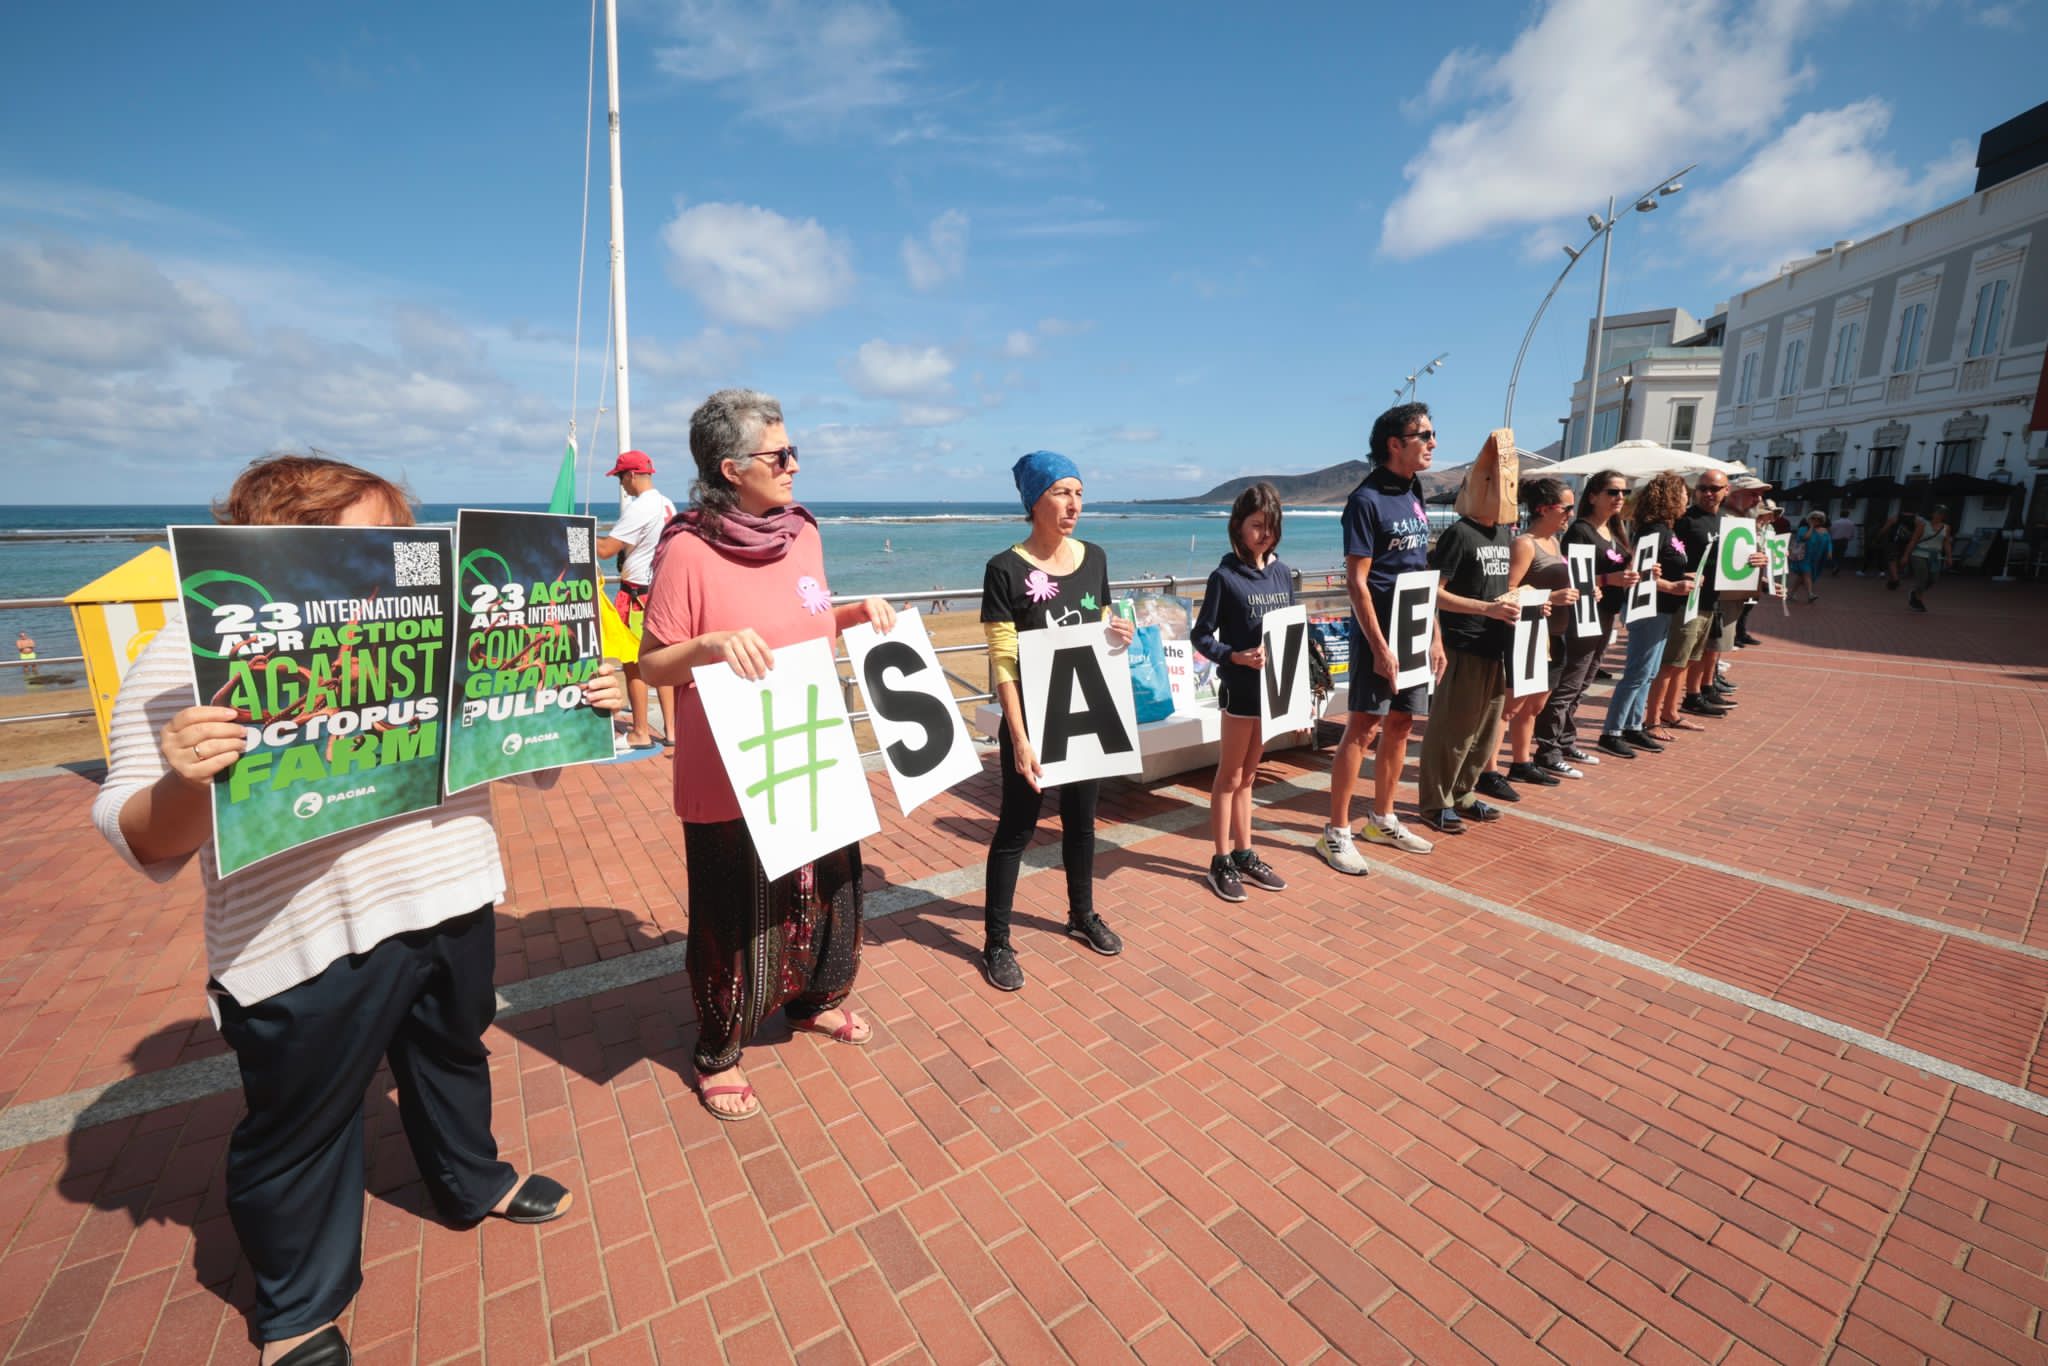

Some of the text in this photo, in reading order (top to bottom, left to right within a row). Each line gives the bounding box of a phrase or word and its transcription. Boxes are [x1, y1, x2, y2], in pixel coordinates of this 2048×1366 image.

[1632, 545, 1656, 609] E
[1721, 527, 1756, 581] C
[305, 595, 443, 626] INTERNATIONAL
[471, 583, 525, 613] 23
[528, 603, 596, 625] INTERNACIONAL
[529, 579, 593, 605] ACTO
[1571, 557, 1597, 624] H
[211, 602, 302, 636] 23
[218, 630, 305, 657] APR
[310, 618, 444, 649] ACTION
[1398, 587, 1431, 673] E
[1520, 603, 1544, 680] T
[466, 621, 599, 673] CONTRA LA
[1263, 622, 1305, 719] V
[229, 641, 443, 721] AGAINST
[464, 659, 599, 699] GRANJA
[465, 684, 591, 721] PULPO
[1039, 645, 1134, 764] A
[464, 705, 472, 726] DE
[864, 641, 954, 777] S
[231, 721, 437, 803] FARM
